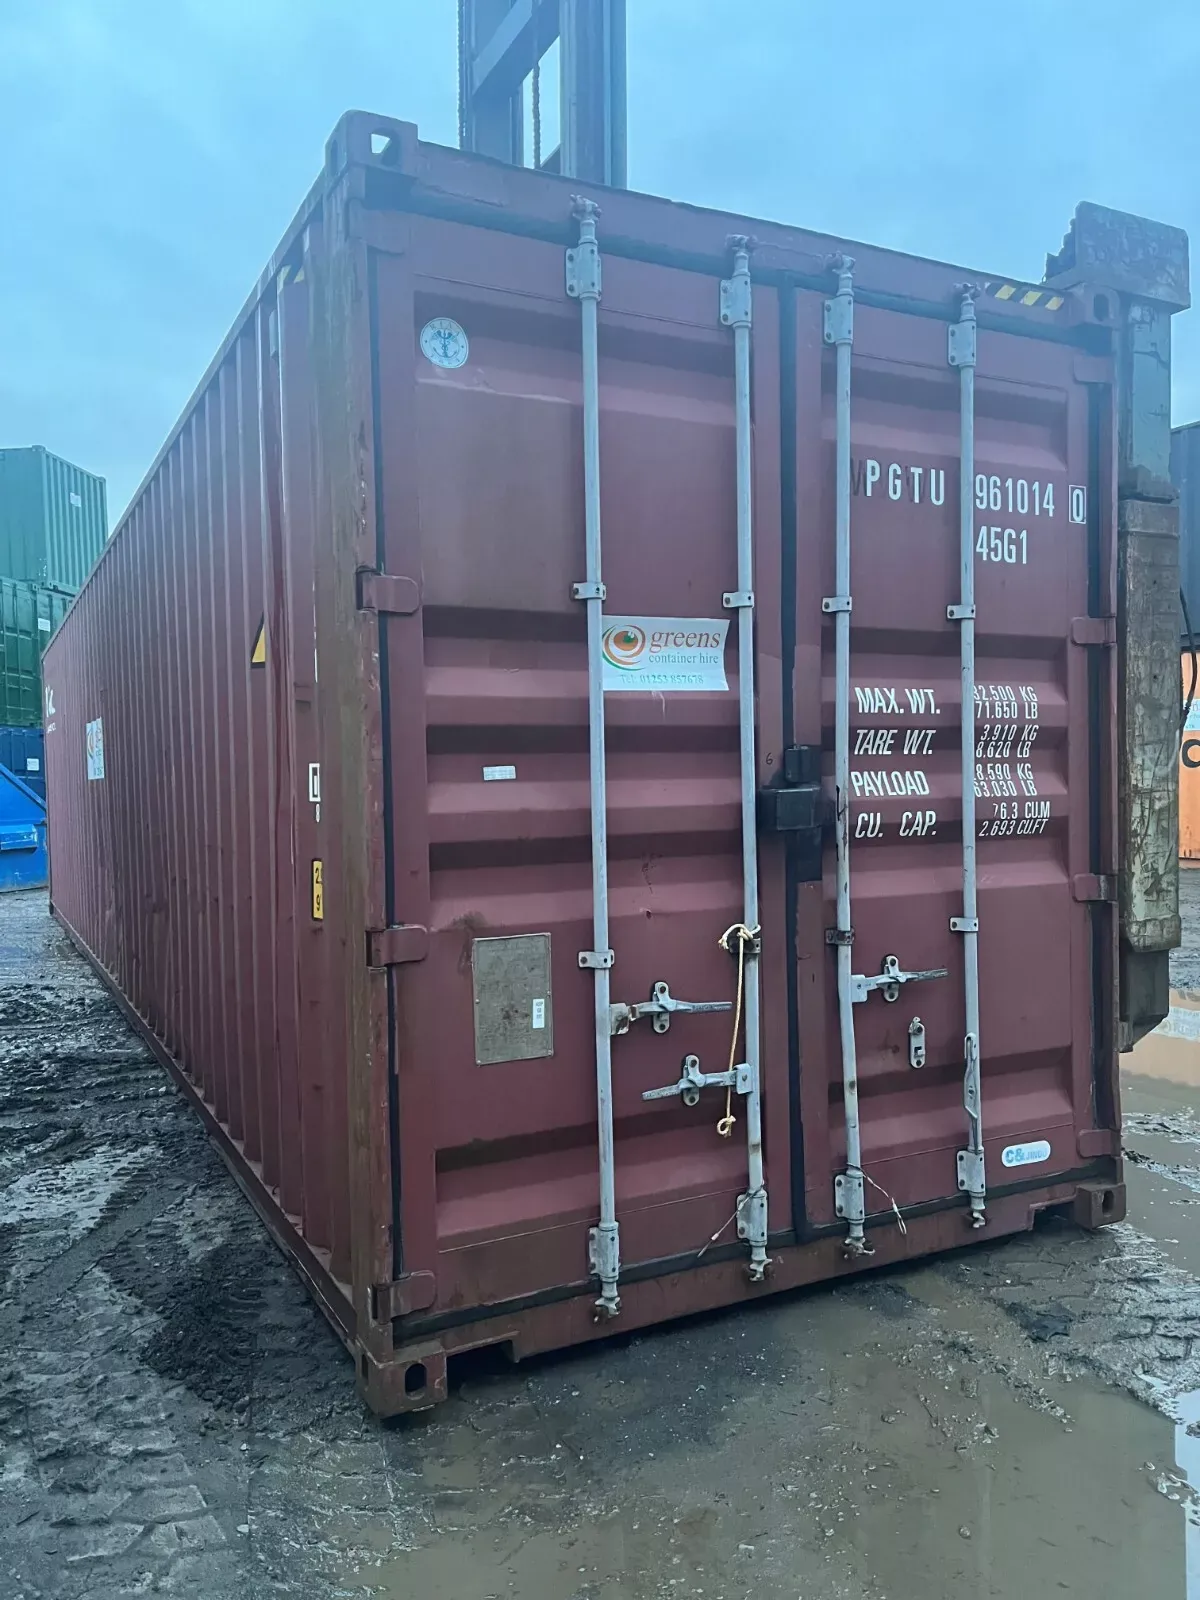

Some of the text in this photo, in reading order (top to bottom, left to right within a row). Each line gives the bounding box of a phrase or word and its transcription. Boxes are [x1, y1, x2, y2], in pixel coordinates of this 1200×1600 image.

[866, 459, 945, 506] PGTU
[975, 474, 1055, 517] 961014
[1072, 487, 1085, 523] 0
[975, 525, 1027, 564] 45G1
[649, 631, 721, 654] greens
[648, 652, 719, 664] container hire
[854, 687, 941, 714] MAX. WT.
[1018, 686, 1038, 701] KG
[975, 701, 1038, 719] 71.650 LB
[980, 724, 1039, 741] 3.910 KG
[854, 729, 936, 755] TARE WT.
[975, 741, 1032, 758] 8.620 LB
[973, 763, 1034, 780] 8.590 KG
[850, 770, 930, 797] PAYLOAD
[1020, 780, 1038, 797] LB
[992, 802, 1018, 820] 76.3
[854, 811, 937, 838] CU. CAP.
[978, 820, 1016, 837] 2.693
